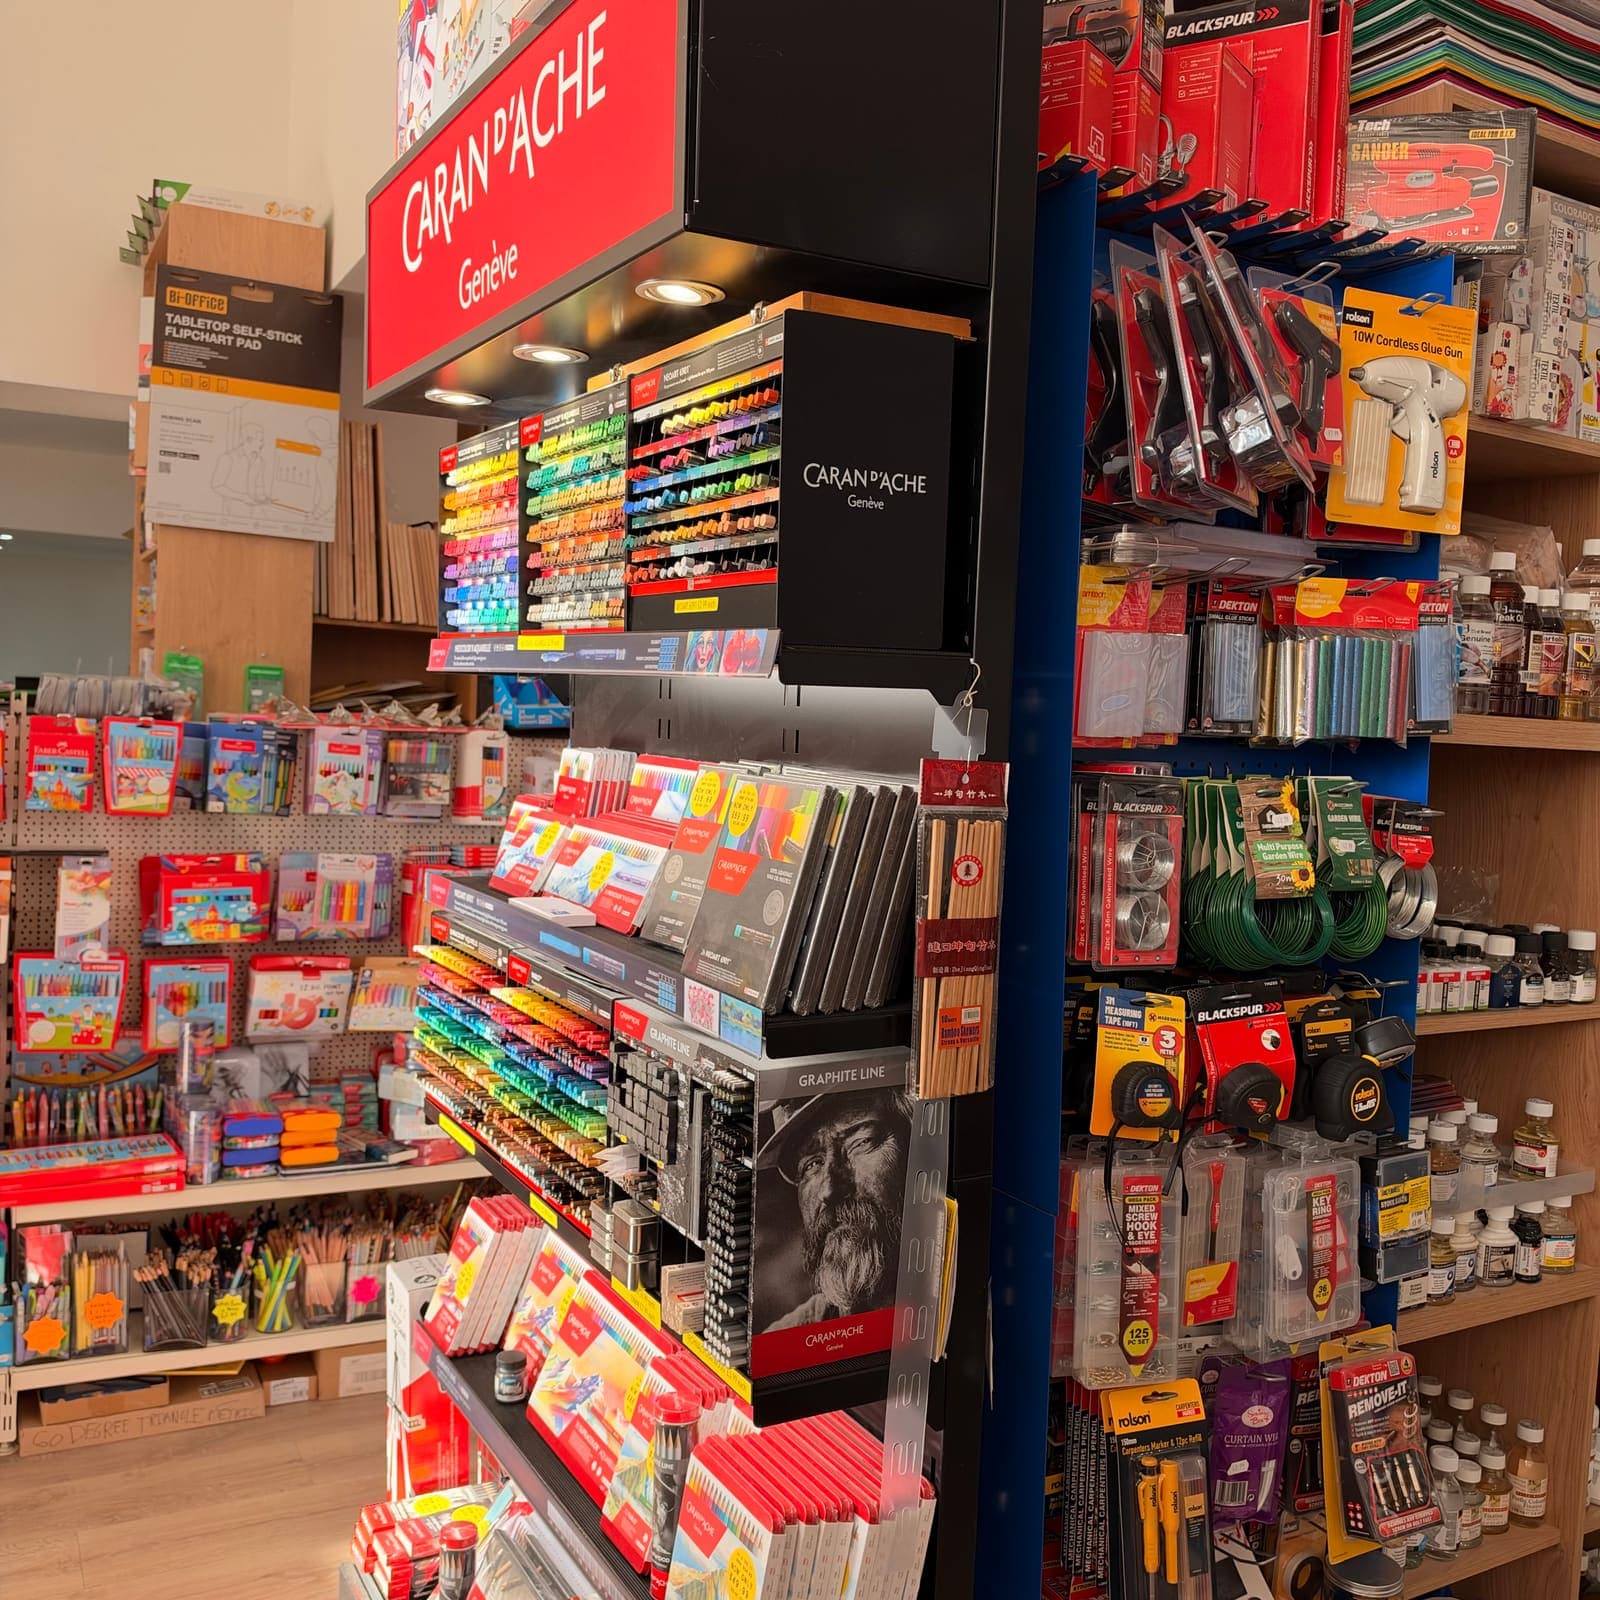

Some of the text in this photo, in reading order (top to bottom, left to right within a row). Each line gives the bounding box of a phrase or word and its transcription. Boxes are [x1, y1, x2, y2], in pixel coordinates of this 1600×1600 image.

[1166, 11, 1254, 39] BLACKSPUR
[1351, 142, 1409, 161] SANDER
[402, 120, 489, 273] CARAN
[1553, 201, 1594, 223] COLORADO
[458, 240, 519, 309] Genève
[1345, 312, 1370, 324] rolson
[164, 312, 303, 346] TABLETOP SELF-STICK
[164, 326, 262, 351] FLIPCHART PAD
[1352, 330, 1463, 359] 10W Cordless Glue Gun
[1431, 450, 1439, 478] rolson
[803, 463, 927, 495] CARAN D'ACHE
[847, 494, 885, 510] Genève
[1219, 601, 1258, 612] DEKTON
[1461, 634, 1491, 643] Genuine
[1112, 802, 1163, 813] BLACKSPUR
[1394, 822, 1422, 832] BLACKSPUR
[1256, 842, 1303, 852] Multi Purpose
[1263, 852, 1303, 861] Garden Wire
[1105, 867, 1113, 910] Galvanised
[1105, 996, 1115, 1005] 3M
[1105, 1006, 1142, 1019] MEASURING
[1198, 1004, 1264, 1022] BLACKSPUR
[1105, 1016, 1122, 1026] TAPE
[650, 1028, 690, 1057] GRAPHITE LINE
[1160, 1030, 1176, 1048] 3
[799, 1065, 886, 1087] GRAPHITE LINE
[1130, 1184, 1159, 1192] DEKTON
[1128, 1204, 1156, 1213] MIXED
[1312, 1195, 1332, 1208] KEY
[1126, 1213, 1158, 1222] SCREW
[1312, 1205, 1332, 1216] RING
[1126, 1221, 1157, 1231] HOOK
[1127, 1231, 1156, 1240] & EYE
[1318, 1285, 1327, 1293] 36
[805, 1331, 836, 1347] CARAN
[1129, 1328, 1149, 1338] 125
[1353, 1370, 1388, 1387] DEKTON
[71, 1418, 129, 1445] DEGREE
[136, 1406, 200, 1434] TRIANGLE
[1118, 1412, 1151, 1428] rolson
[1224, 1434, 1262, 1444] CURTAIN
[1122, 1444, 1151, 1456] Carpenters
[1150, 1441, 1170, 1451] Marker
[1070, 1443, 1078, 1501] CARPENTERS
[1078, 1448, 1086, 1506] CARPENTERS
[1088, 1453, 1097, 1512] CARPENTERS
[1067, 1502, 1076, 1561] MECHANICAL
[1075, 1507, 1084, 1566] MECHANICAL
[1085, 1514, 1094, 1572] MECHANICAL
[1097, 1520, 1105, 1579] MECHANICAL
